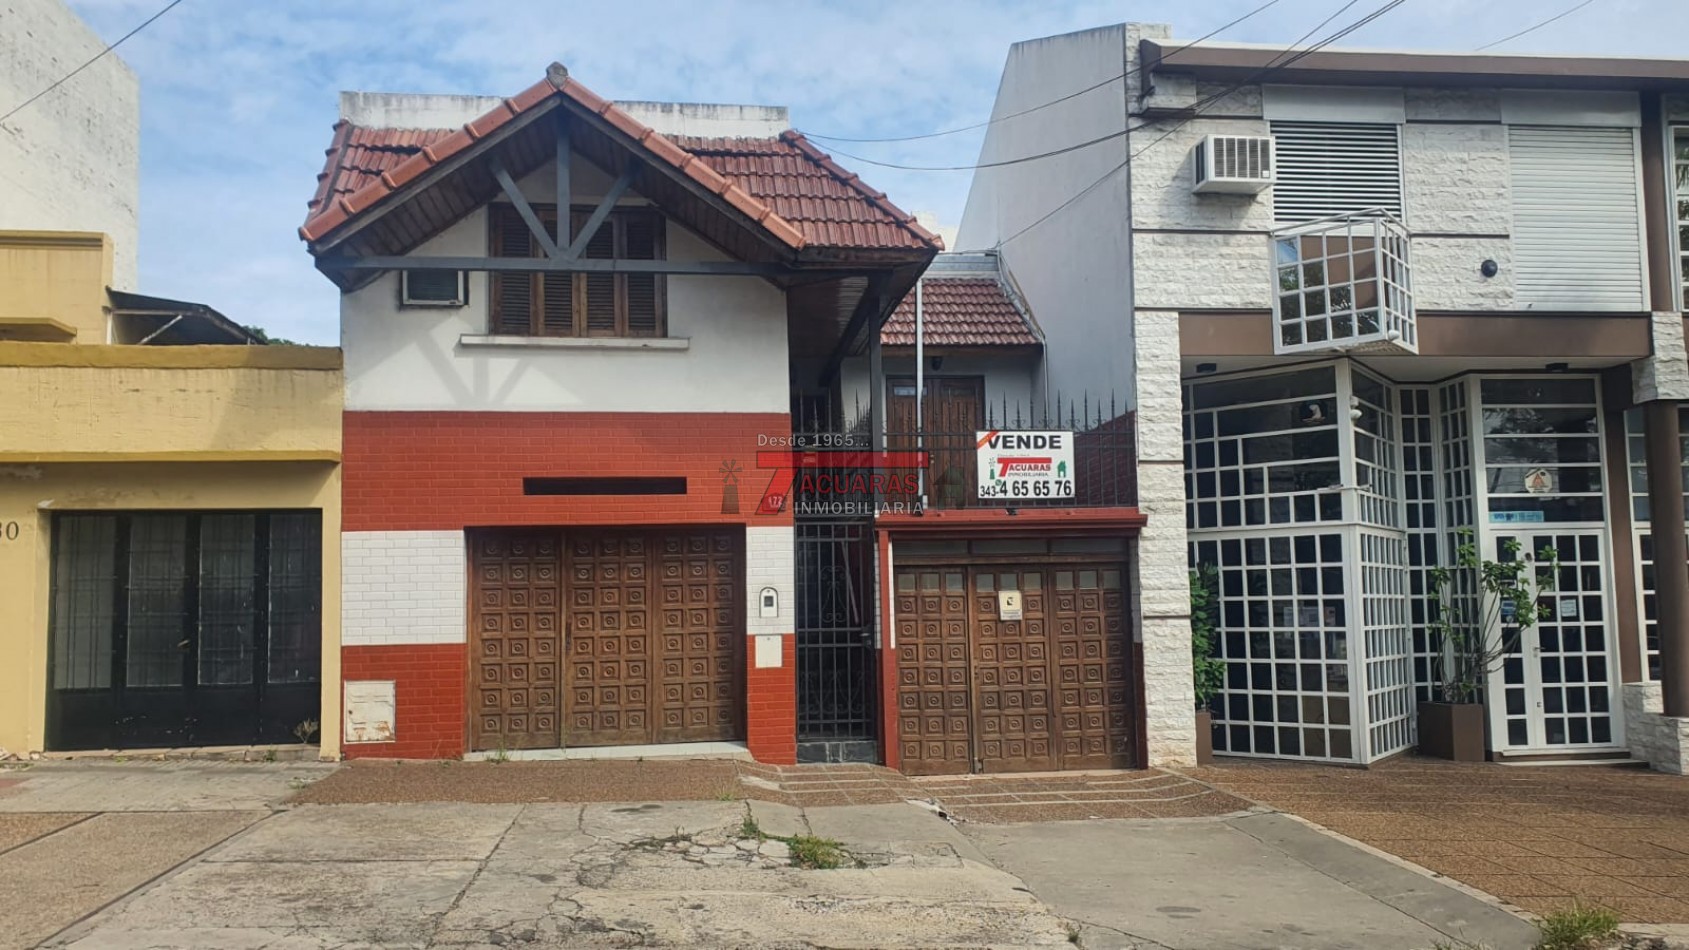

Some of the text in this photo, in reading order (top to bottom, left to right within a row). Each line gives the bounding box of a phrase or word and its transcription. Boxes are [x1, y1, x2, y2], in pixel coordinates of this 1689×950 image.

[988, 435, 1062, 449] VENDE
[1012, 480, 1029, 497] 65
[1033, 480, 1050, 497] 65
[1054, 480, 1072, 497] 76
[0, 521, 20, 541] 0
